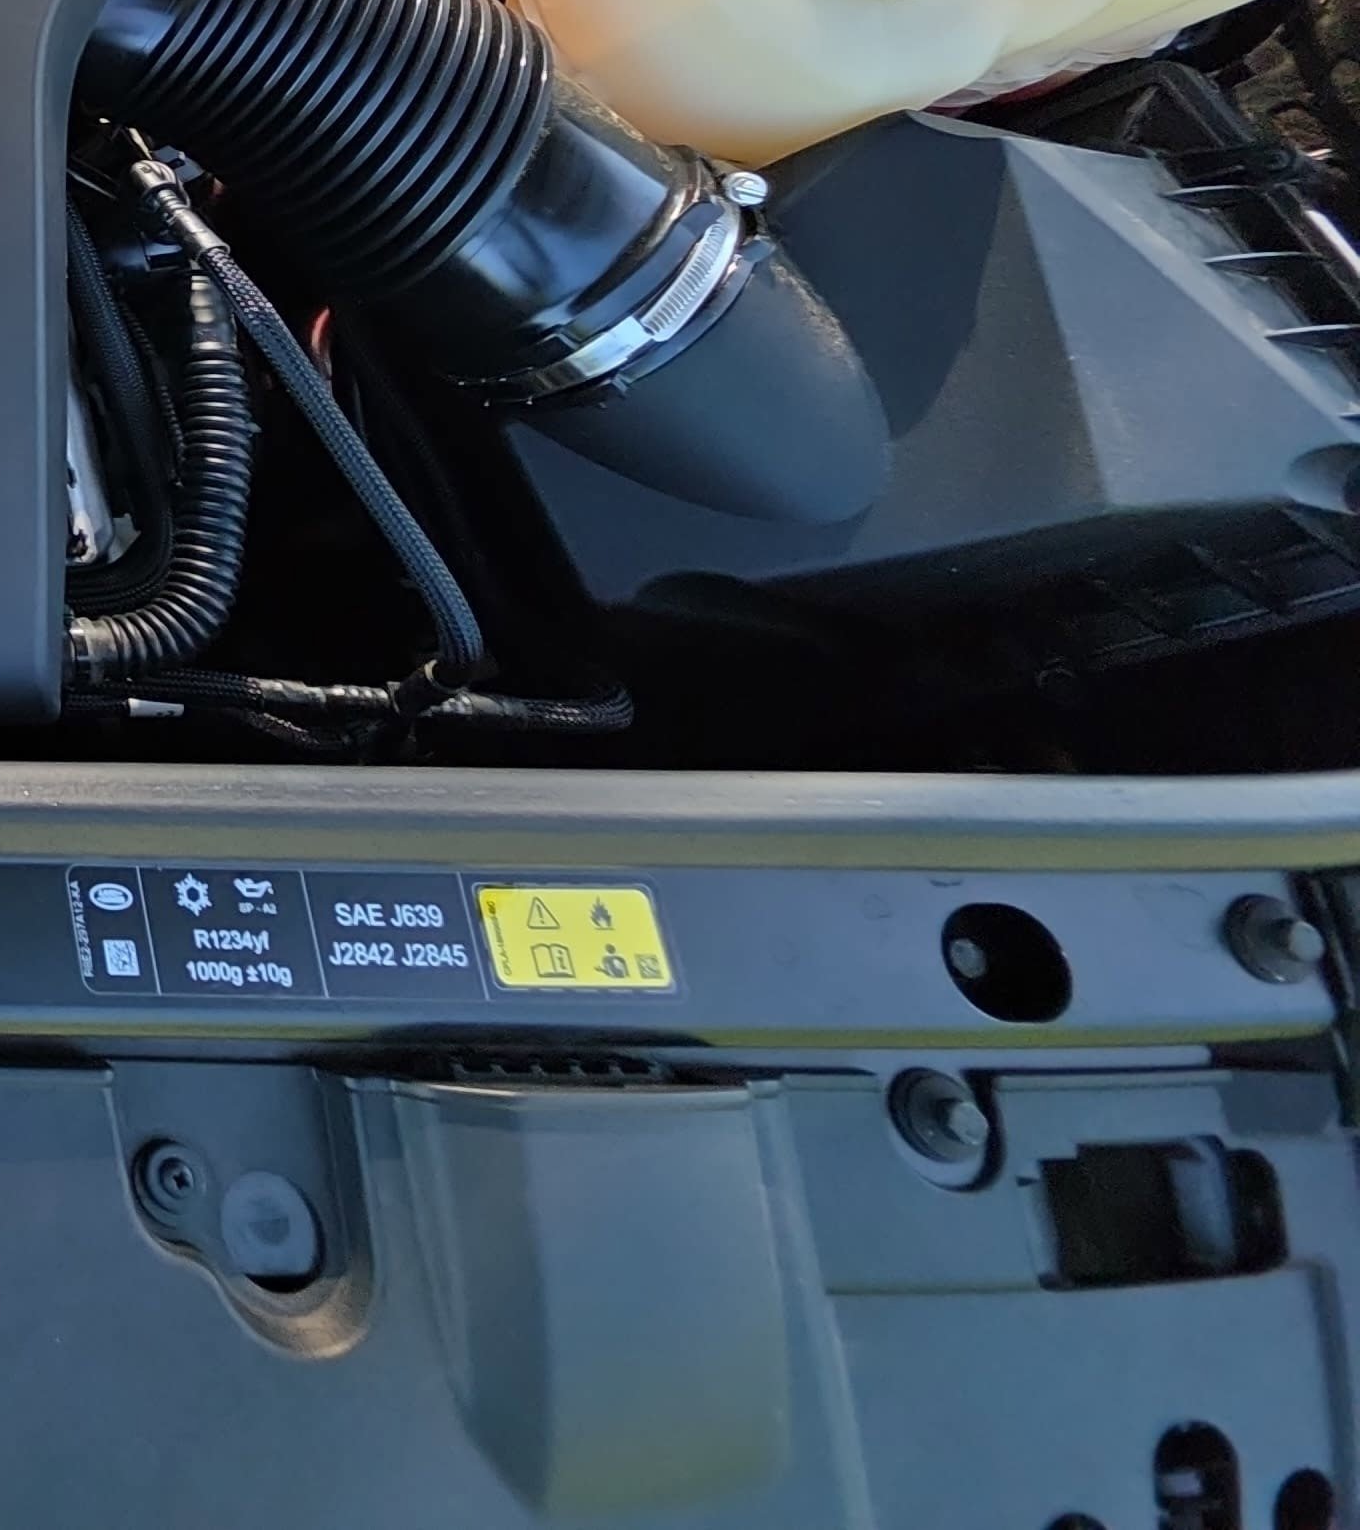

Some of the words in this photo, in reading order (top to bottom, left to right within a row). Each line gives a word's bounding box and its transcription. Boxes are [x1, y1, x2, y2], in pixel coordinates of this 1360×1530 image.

[335, 903, 386, 927] SAE
[390, 904, 444, 928] J639
[329, 942, 397, 967] J2842
[401, 943, 468, 968] J2845
[185, 961, 244, 987] 1000g
[245, 962, 293, 988] ±10g
